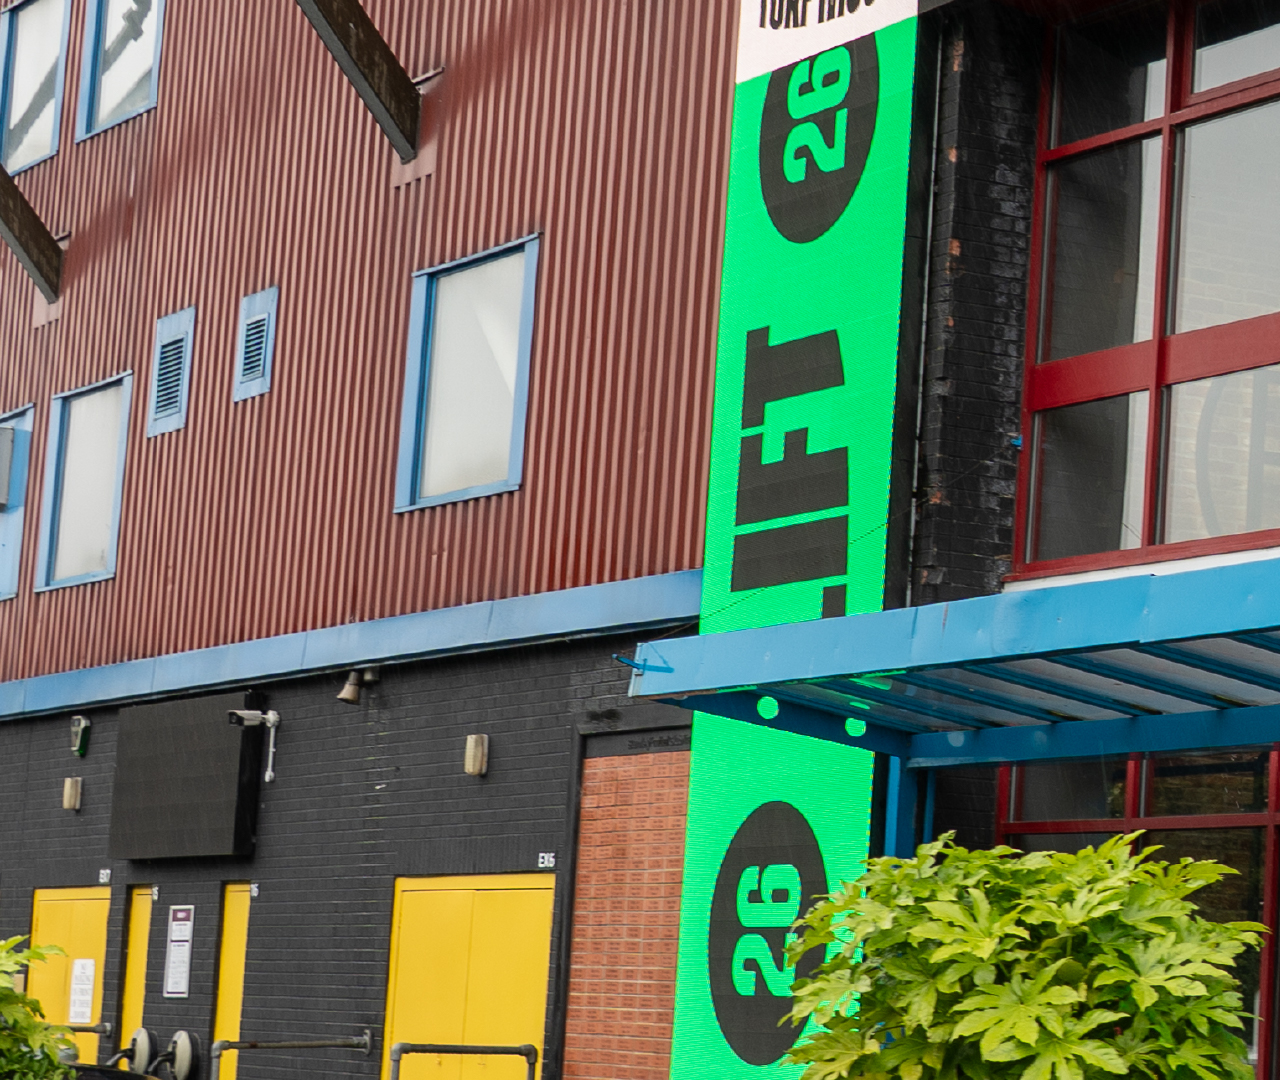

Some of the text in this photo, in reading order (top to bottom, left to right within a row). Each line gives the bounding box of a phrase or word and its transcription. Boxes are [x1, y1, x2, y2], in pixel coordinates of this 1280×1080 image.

[783, 46, 851, 183] 26
[731, 326, 848, 619] IFT
[732, 863, 803, 997] 26
